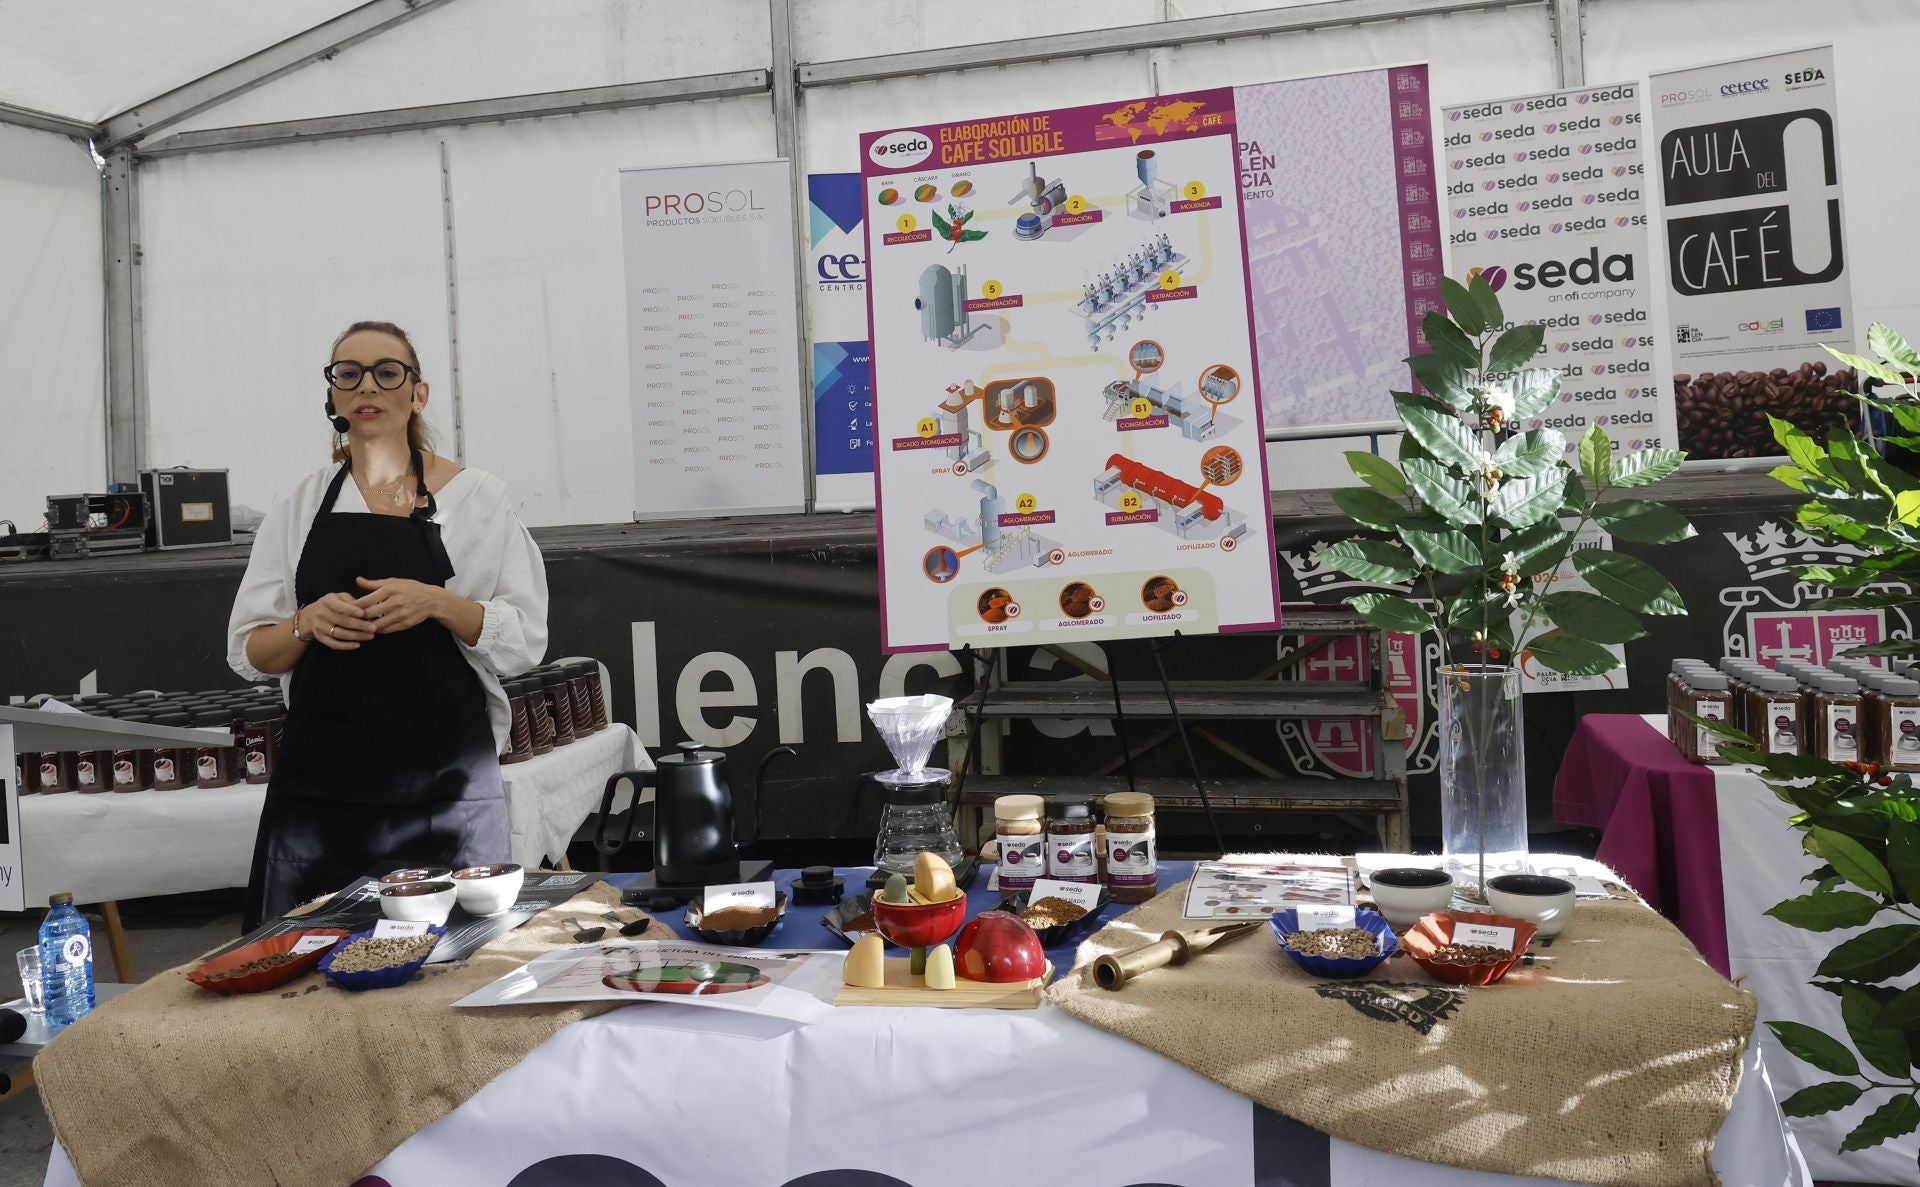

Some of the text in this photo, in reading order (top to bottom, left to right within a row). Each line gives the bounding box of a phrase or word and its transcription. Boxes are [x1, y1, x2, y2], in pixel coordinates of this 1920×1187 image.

[1785, 69, 1825, 85] SEDA
[1720, 78, 1769, 95] cetece
[1463, 86, 1634, 119] seda seda seda
[1661, 87, 1712, 104] PROSOL
[940, 116, 1050, 143] ELABORACIÓN DE
[1444, 113, 1641, 147] eda seda seda se
[890, 139, 927, 153] seda
[942, 139, 984, 165] CAFÉ
[988, 131, 1065, 159] SOLUBLE
[1239, 141, 1262, 156] PA
[1466, 137, 1636, 168] seda seda seda
[1671, 128, 1750, 179] AULA
[1241, 156, 1276, 172] LEN
[1242, 173, 1272, 188] CIA
[1447, 164, 1644, 195] eda seda seda se
[1757, 172, 1778, 189] DEL
[1244, 190, 1274, 200] IENTO
[1468, 188, 1639, 217] seda seda seda
[645, 190, 765, 216] PROSOL
[1180, 200, 1211, 210] MOLIENDA
[647, 218, 700, 227] PRODUCTOS
[703, 215, 746, 224] SOLUBLES
[1061, 214, 1093, 224] TOSTACIÓN
[1450, 214, 1647, 244] eda seda seda se
[887, 233, 927, 243] RECOLECCIÓN
[1679, 210, 1783, 289] CAFÉ
[1513, 246, 1634, 291] seda
[820, 283, 862, 291] CENTRO
[1166, 276, 1173, 284] 4
[989, 285, 995, 293] 5
[1152, 289, 1189, 299] EXTRACCIÓN
[1548, 287, 1636, 303] an ofi company
[968, 297, 1018, 309] CONCENTRACIÓN
[1539, 308, 1647, 328] seda seda
[1572, 336, 1654, 351] seda se
[1608, 359, 1649, 374] seda
[1575, 386, 1657, 401] seda se
[1136, 404, 1147, 413] B1
[1120, 418, 1165, 429] CONGELACIÓN
[1545, 410, 1653, 428] seda seda
[1645, 437, 1661, 449] se
[1019, 498, 1033, 508] A2
[1124, 497, 1137, 507] B2
[1003, 513, 1051, 525] AGLOMERACIÓN
[1111, 512, 1151, 523] SUBLIMACIÓN
[1068, 549, 1113, 558] AGLOMERADO
[1176, 542, 1216, 551] LIOFILIZADO
[1058, 618, 1104, 628] AGLOMERADO
[1143, 613, 1181, 622] LIOFILIZADO
[988, 624, 1007, 632] SPRAY
